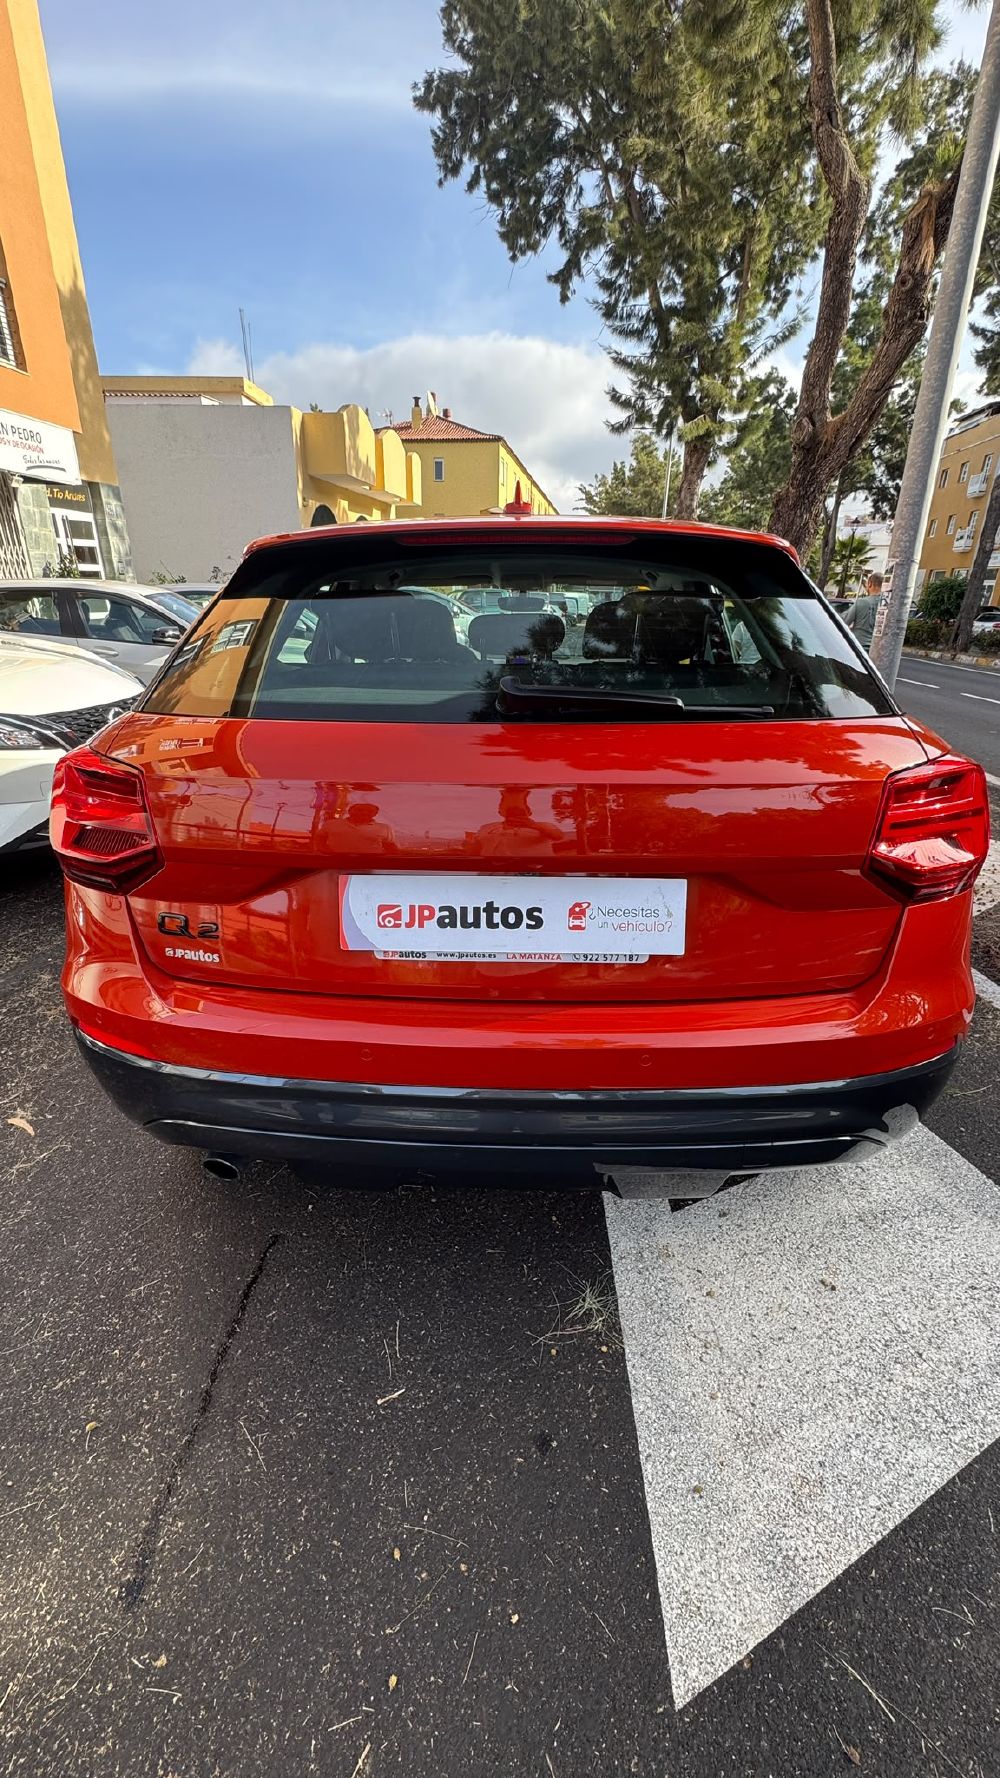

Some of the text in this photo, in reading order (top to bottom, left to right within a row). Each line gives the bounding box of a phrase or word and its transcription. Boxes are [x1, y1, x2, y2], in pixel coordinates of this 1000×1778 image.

[0, 421, 42, 444] N PEDRO
[12, 439, 20, 448] DE
[405, 901, 544, 930] JPautos
[588, 906, 660, 920] ¿Necesitas
[597, 920, 673, 933] un vehículo?
[174, 948, 220, 963] JPautos
[389, 950, 427, 959] JPautos
[436, 951, 497, 959] www.jpautos.es
[582, 954, 600, 962] 922
[603, 954, 619, 962] 577
[623, 954, 640, 962] 187
